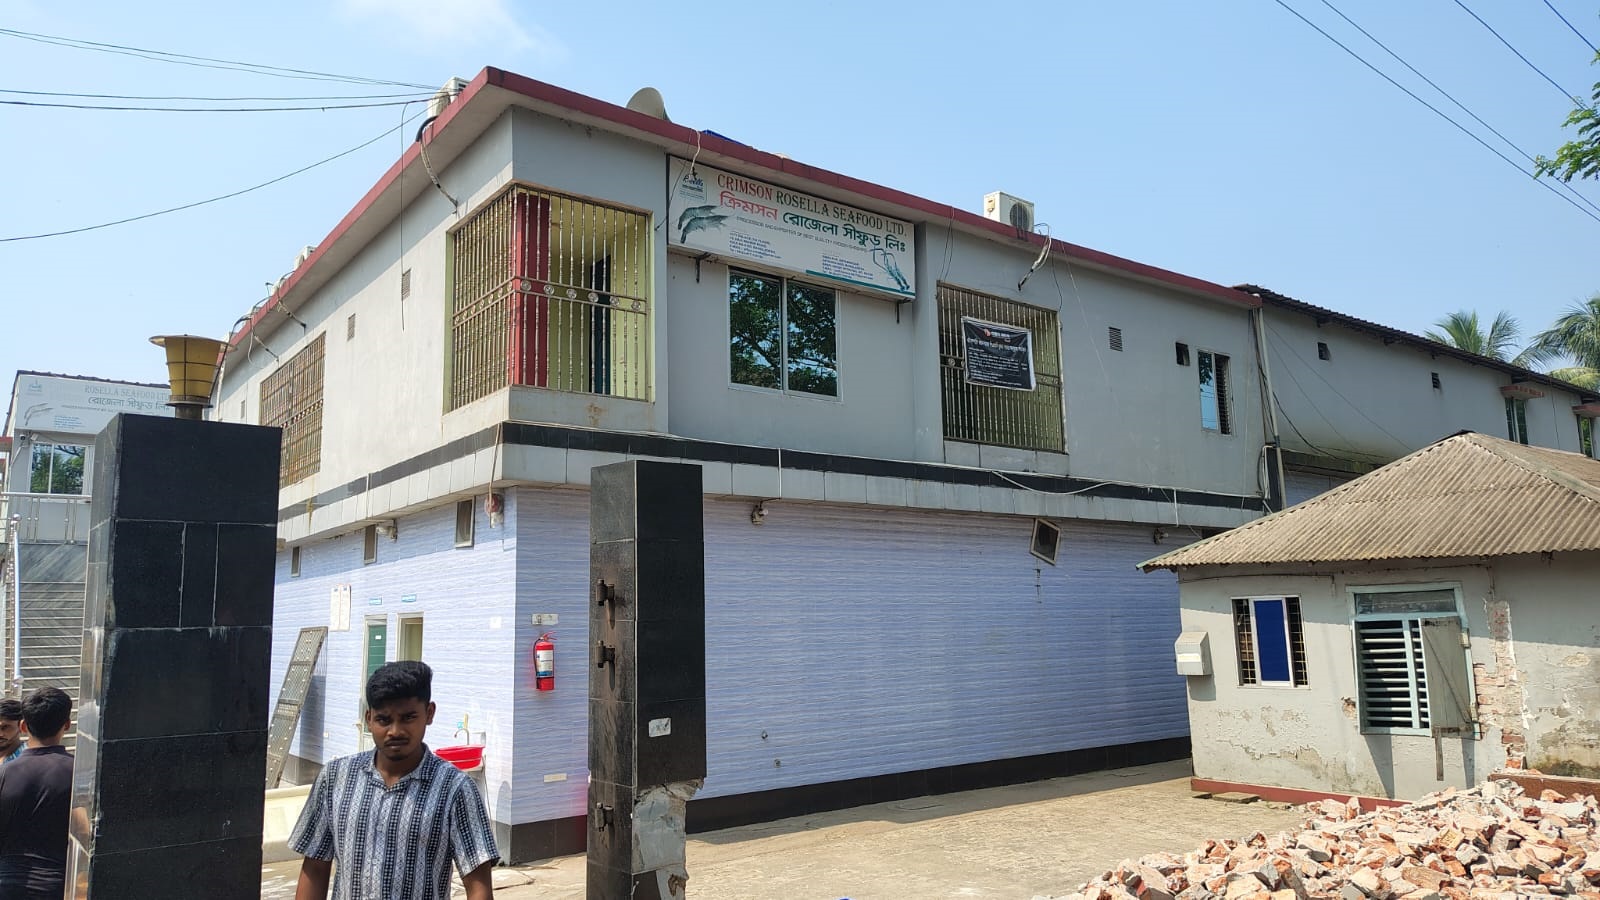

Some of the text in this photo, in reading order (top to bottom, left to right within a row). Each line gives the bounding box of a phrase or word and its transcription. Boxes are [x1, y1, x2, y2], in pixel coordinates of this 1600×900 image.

[717, 173, 908, 238] CRIMSON ROSELLA SEAFOOD LTD.
[719, 190, 779, 221] ক্রিমসন
[782, 211, 839, 237] রোজেলা
[842, 223, 881, 248] সীফুড
[885, 234, 907, 253] লিঃ
[84, 385, 119, 397] ROSELLA
[88, 396, 125, 408] রোজেলা
